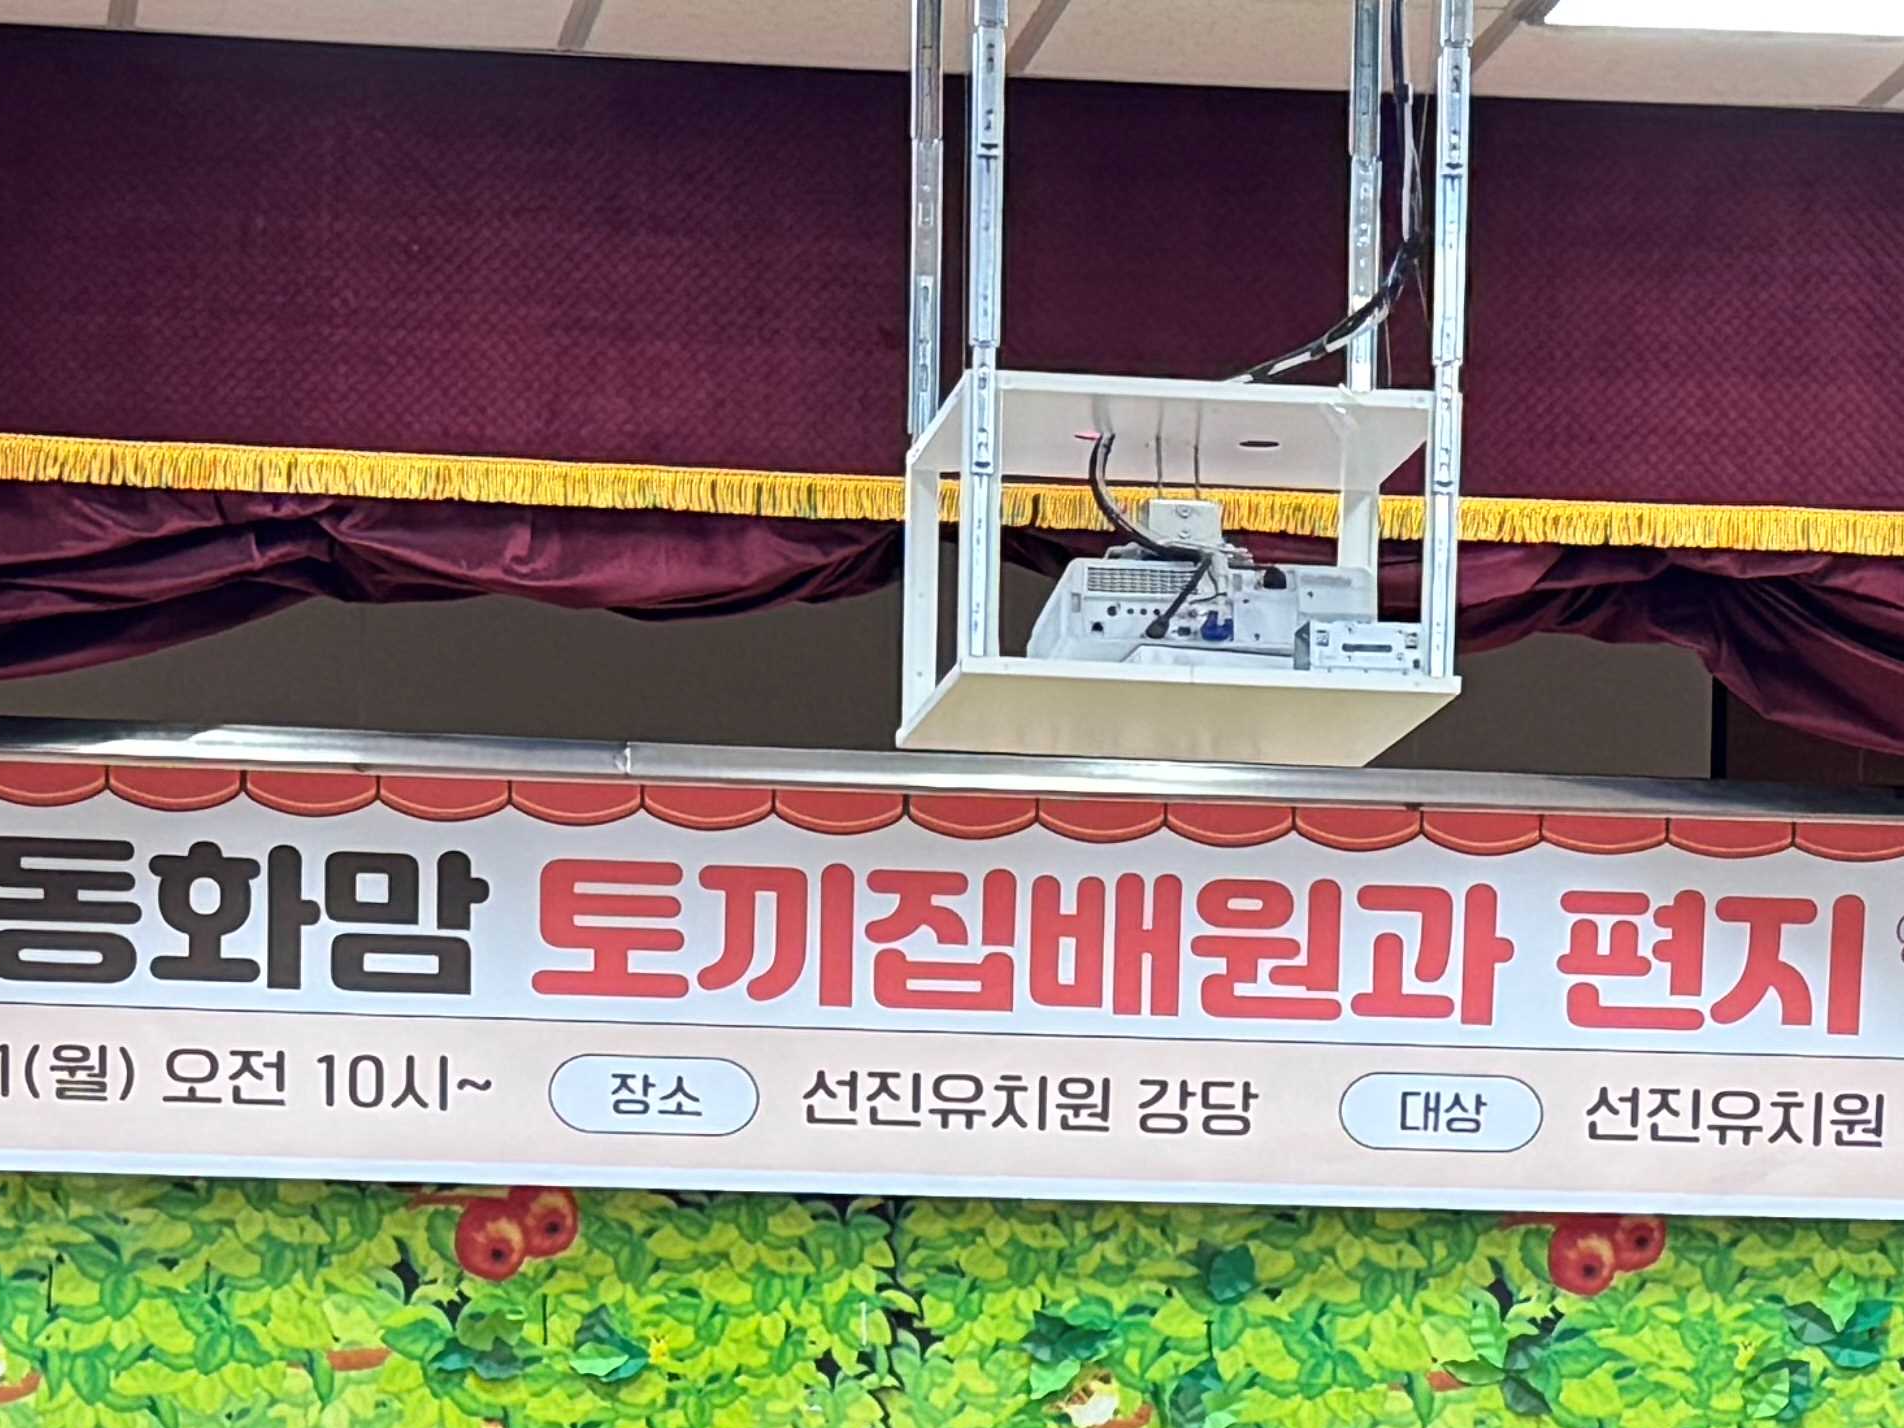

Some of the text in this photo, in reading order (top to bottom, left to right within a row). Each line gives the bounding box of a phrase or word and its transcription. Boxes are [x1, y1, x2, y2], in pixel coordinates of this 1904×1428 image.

[532, 857, 1515, 1025] 토끼집배원과
[1556, 889, 1867, 1036] 편지
[162, 1048, 286, 1107] 오전
[317, 1054, 493, 1112] 10시~
[611, 1072, 703, 1117] 장소
[802, 1070, 1111, 1133] 선진유치원
[1138, 1079, 1260, 1137] 강당
[1400, 1091, 1489, 1134] 대상
[1586, 1086, 1885, 1149] 선진유치원
